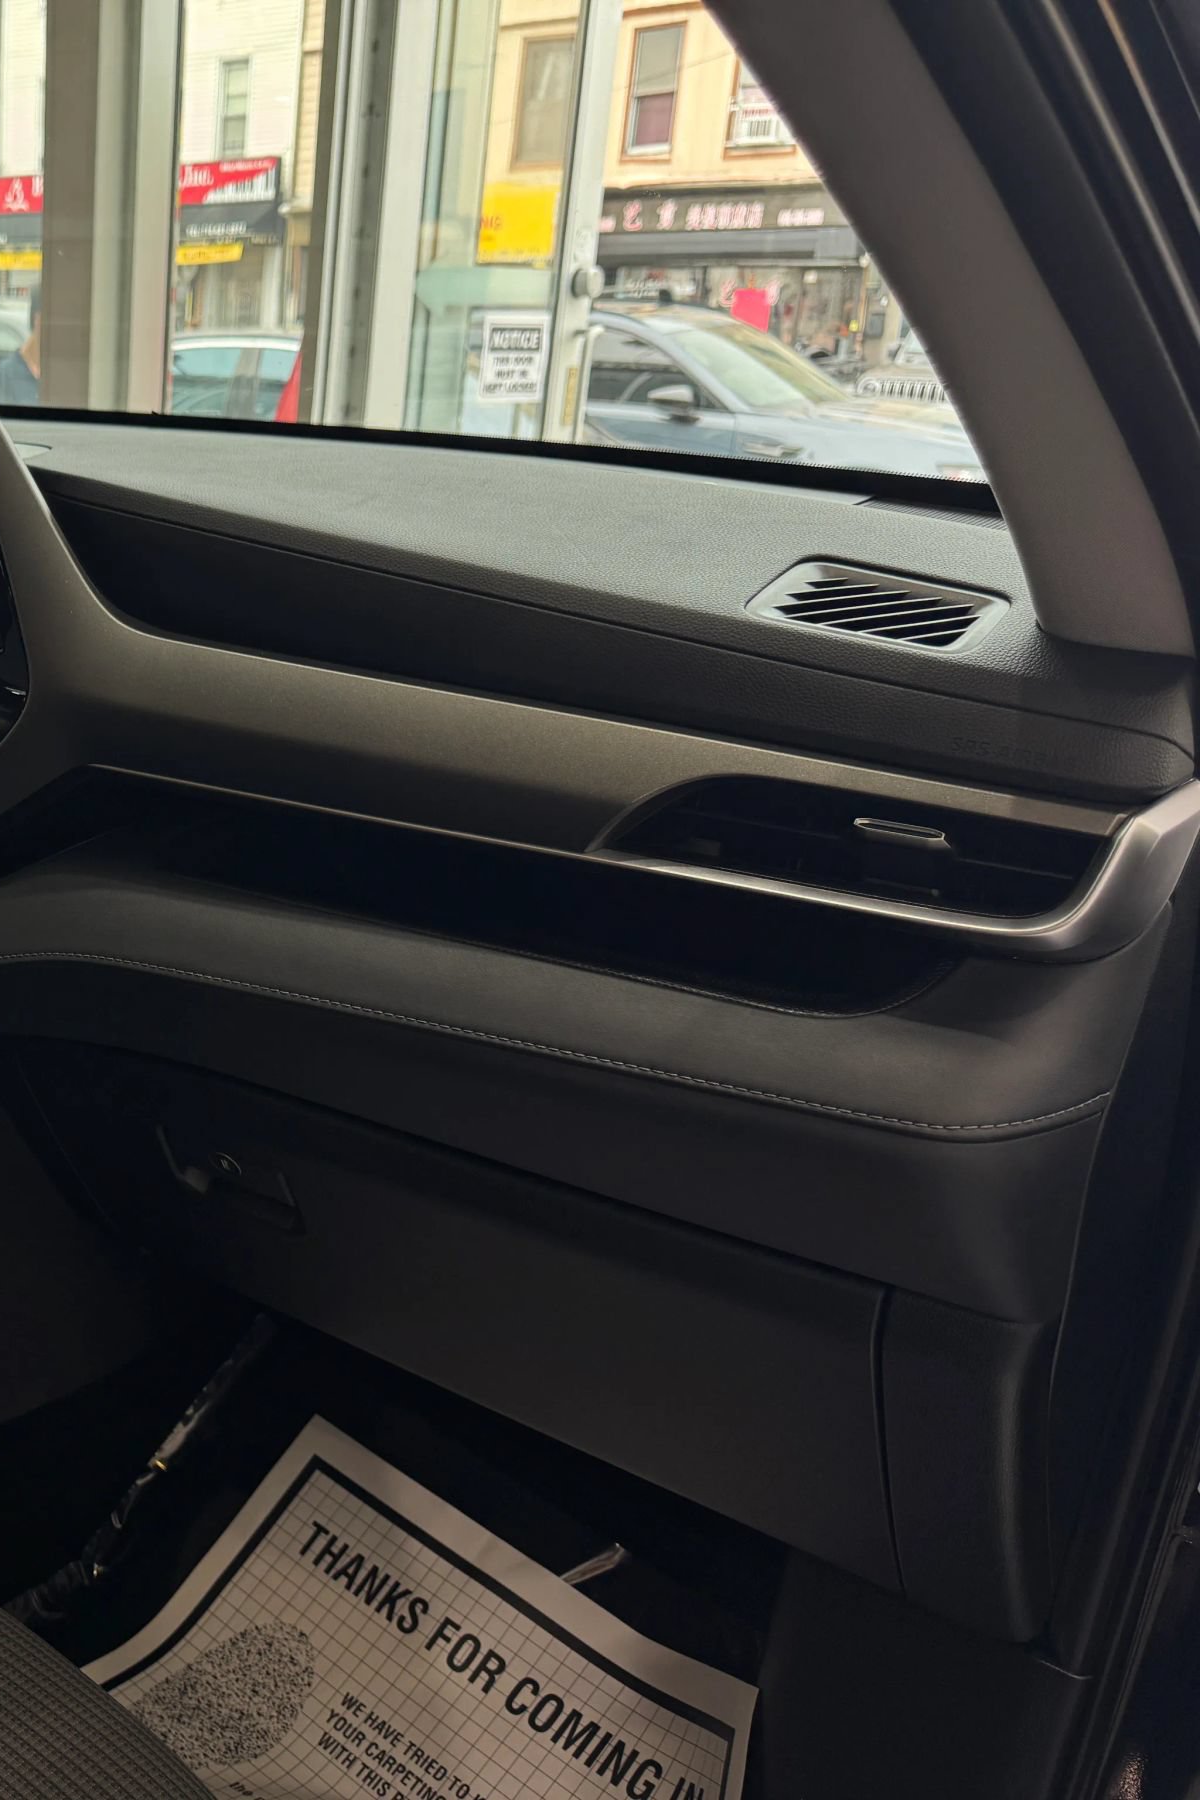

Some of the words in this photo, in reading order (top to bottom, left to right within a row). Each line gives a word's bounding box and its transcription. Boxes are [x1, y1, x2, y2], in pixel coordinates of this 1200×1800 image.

[492, 330, 540, 349] NOTICE
[300, 1521, 429, 1634] THANKS
[425, 1617, 506, 1694] FOR
[505, 1677, 663, 1800] COMING
[324, 1709, 366, 1747] YOUR
[341, 1692, 367, 1717] WE
[364, 1711, 405, 1747] HAVE
[403, 1741, 448, 1781] TRIED
[448, 1776, 470, 1799] TO
[229, 1782, 253, 1796] the
[318, 1732, 356, 1769] WITH
[356, 1762, 390, 1797] THIS
